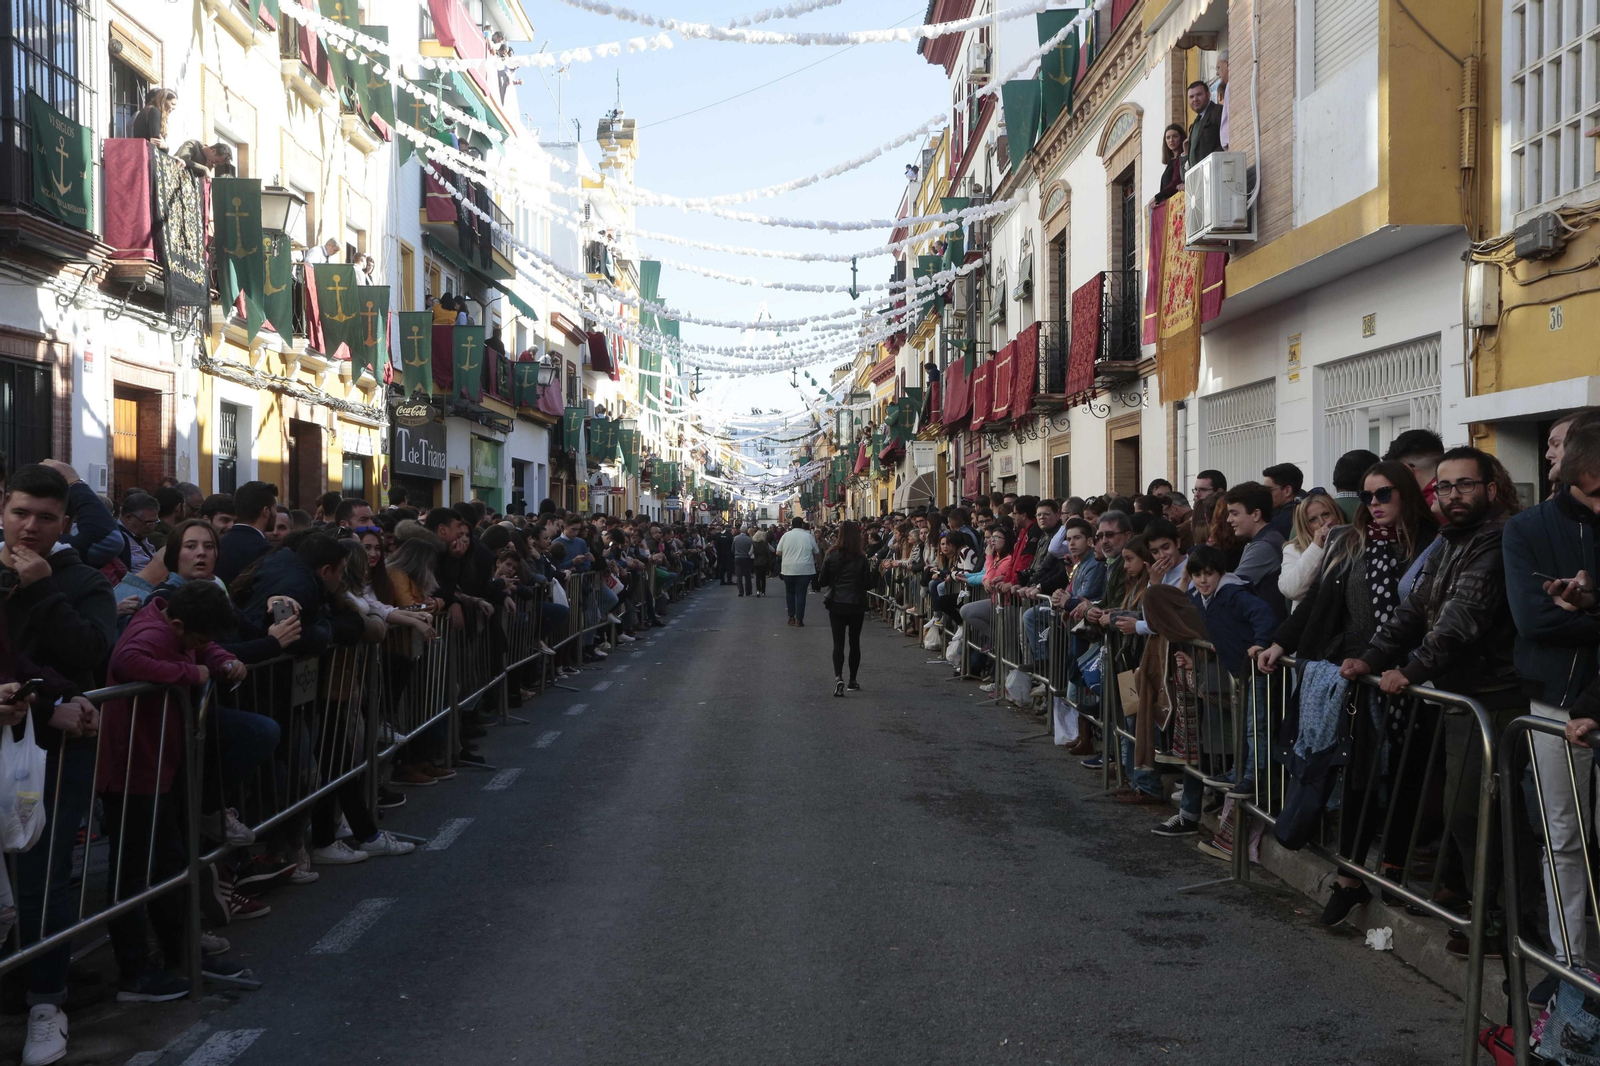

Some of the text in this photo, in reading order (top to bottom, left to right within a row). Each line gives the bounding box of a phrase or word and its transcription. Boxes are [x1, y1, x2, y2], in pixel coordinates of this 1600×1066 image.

[55, 119, 75, 138] SIGLOS
[1550, 305, 1563, 330] 36
[396, 427, 410, 462] T
[408, 447, 420, 465] de
[419, 438, 446, 469] Triana
